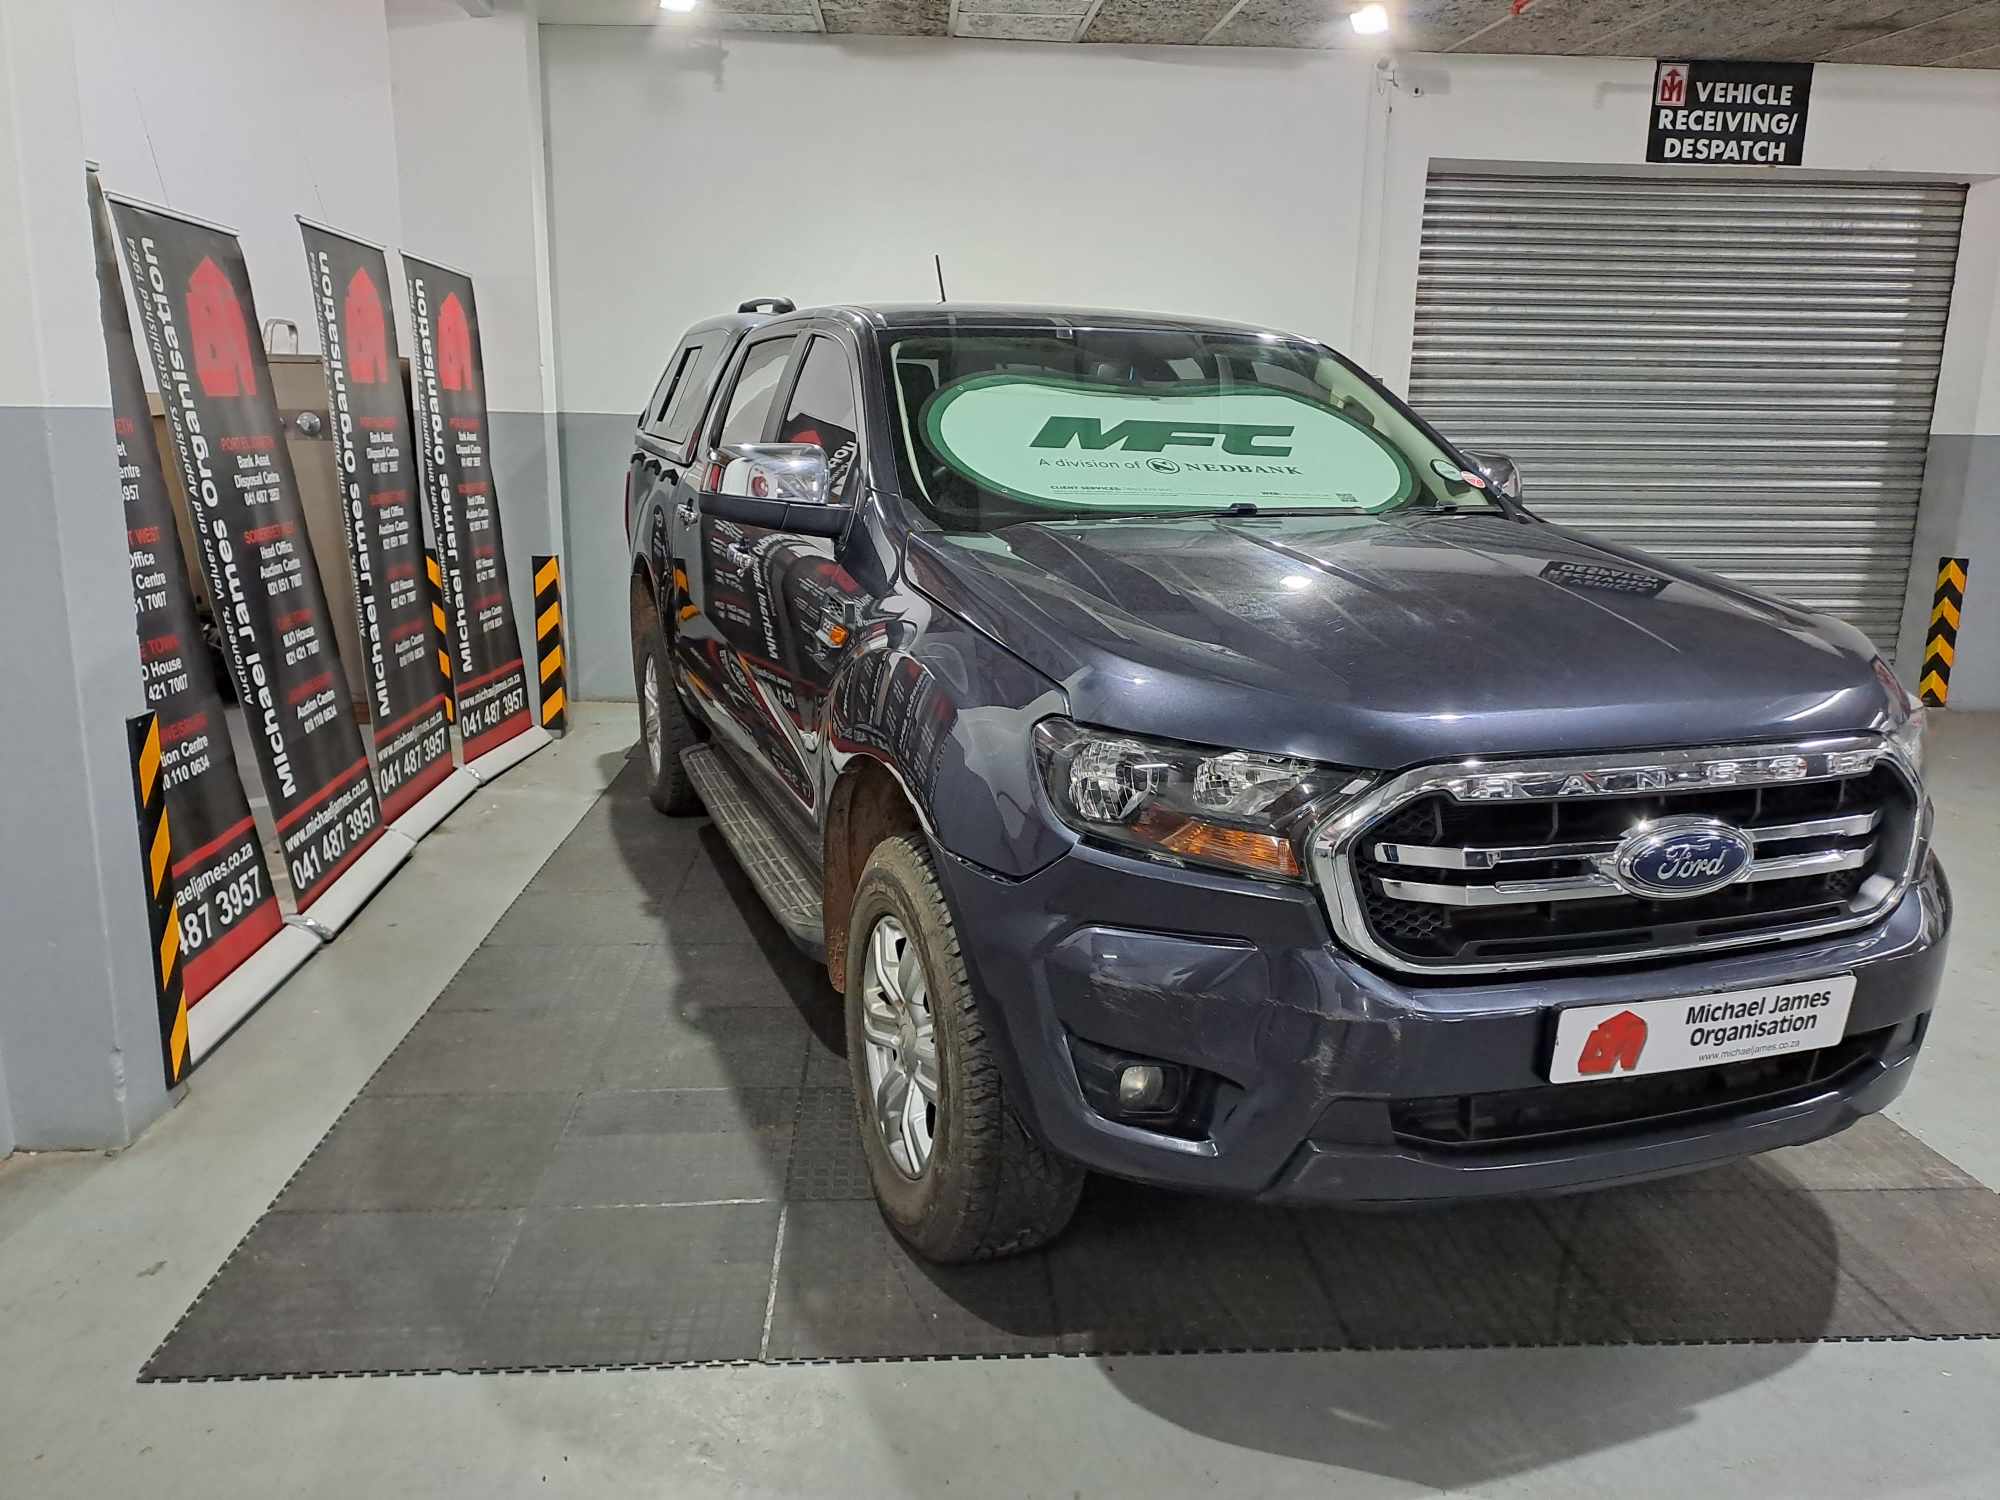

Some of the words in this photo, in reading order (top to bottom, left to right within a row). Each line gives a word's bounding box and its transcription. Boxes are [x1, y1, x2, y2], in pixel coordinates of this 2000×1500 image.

[1696, 81, 1793, 106] VEHICLE
[1658, 109, 1798, 135] RECEIVING/
[1663, 138, 1787, 162] DESPATCH
[126, 236, 145, 284] 1964
[137, 287, 172, 390] Established
[318, 251, 356, 473] Organisation
[141, 237, 218, 507] Organisation
[415, 278, 446, 465] Organisation
[169, 406, 199, 497] Appraisers
[1029, 416, 1294, 456] MFC
[1039, 458, 1051, 466] A
[1055, 458, 1120, 469] division
[1124, 460, 1143, 469] of
[1183, 463, 1303, 475] NEDBANK
[121, 484, 140, 501] 957
[191, 500, 208, 533] and
[439, 473, 459, 562] James
[350, 483, 373, 587] James
[135, 571, 167, 589] Centre
[203, 538, 225, 600] Valuers
[212, 519, 255, 642] James
[145, 590, 167, 611] 7007
[449, 568, 473, 672] Michael
[150, 656, 183, 677] House
[222, 606, 254, 705] Auctioneers,
[363, 595, 391, 717] Michael
[148, 681, 168, 702] 421
[168, 673, 189, 695] 7007
[462, 710, 482, 737] 041
[484, 700, 500, 725] 487
[502, 687, 523, 716] 3957
[245, 653, 297, 798] Michael
[160, 747, 180, 767] tion
[181, 735, 209, 758] Centre
[170, 765, 189, 785] 110
[190, 754, 211, 776] 0634
[380, 759, 402, 793] 041
[403, 745, 422, 777] 487
[422, 727, 445, 762] 3957
[284, 778, 369, 853] www.michaeljames.co.za
[292, 845, 322, 890] 041
[322, 822, 346, 862] 487
[346, 796, 376, 841] 3957
[1657, 843, 1726, 880] Ford
[176, 842, 254, 908] aeljames.co.za
[215, 864, 262, 925] 3957
[1685, 996, 1766, 1025] Michael
[1769, 991, 1832, 1014] James
[1690, 1013, 1818, 1047] Organisation
[1698, 1039, 1801, 1062] www.michaeljames.co.za
